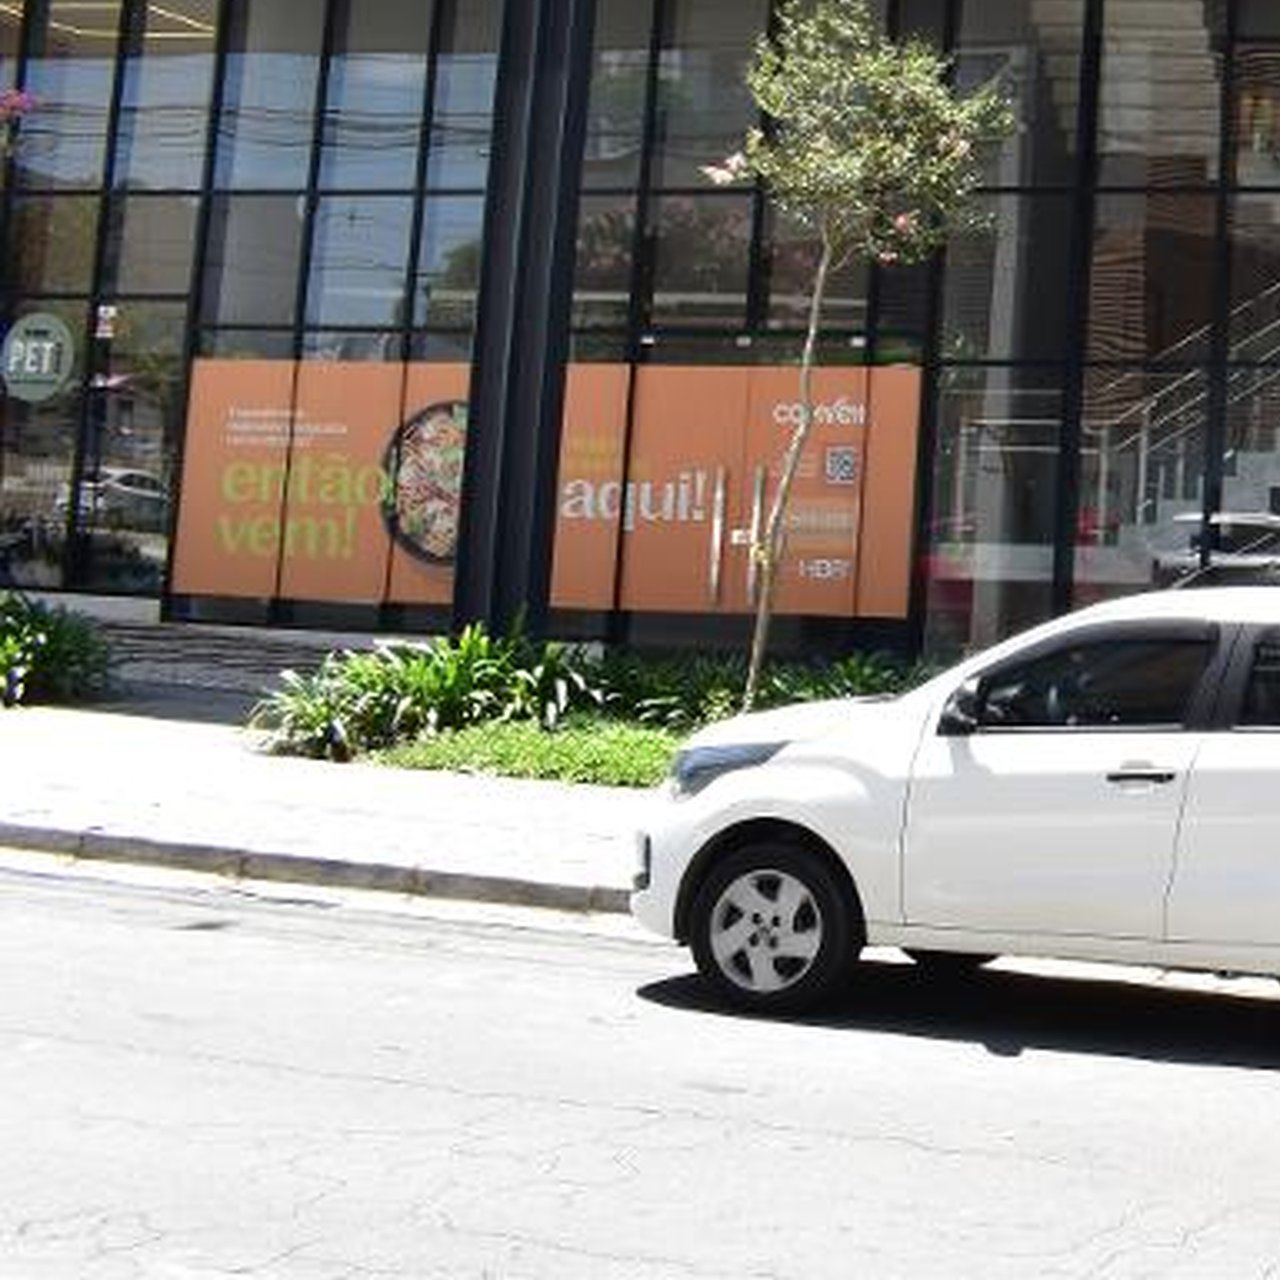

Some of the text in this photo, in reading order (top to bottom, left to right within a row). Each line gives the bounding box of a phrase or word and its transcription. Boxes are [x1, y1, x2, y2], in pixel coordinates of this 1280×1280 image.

[220, 451, 391, 507] então
[560, 471, 706, 533] aqui!
[212, 505, 359, 561] vem!
